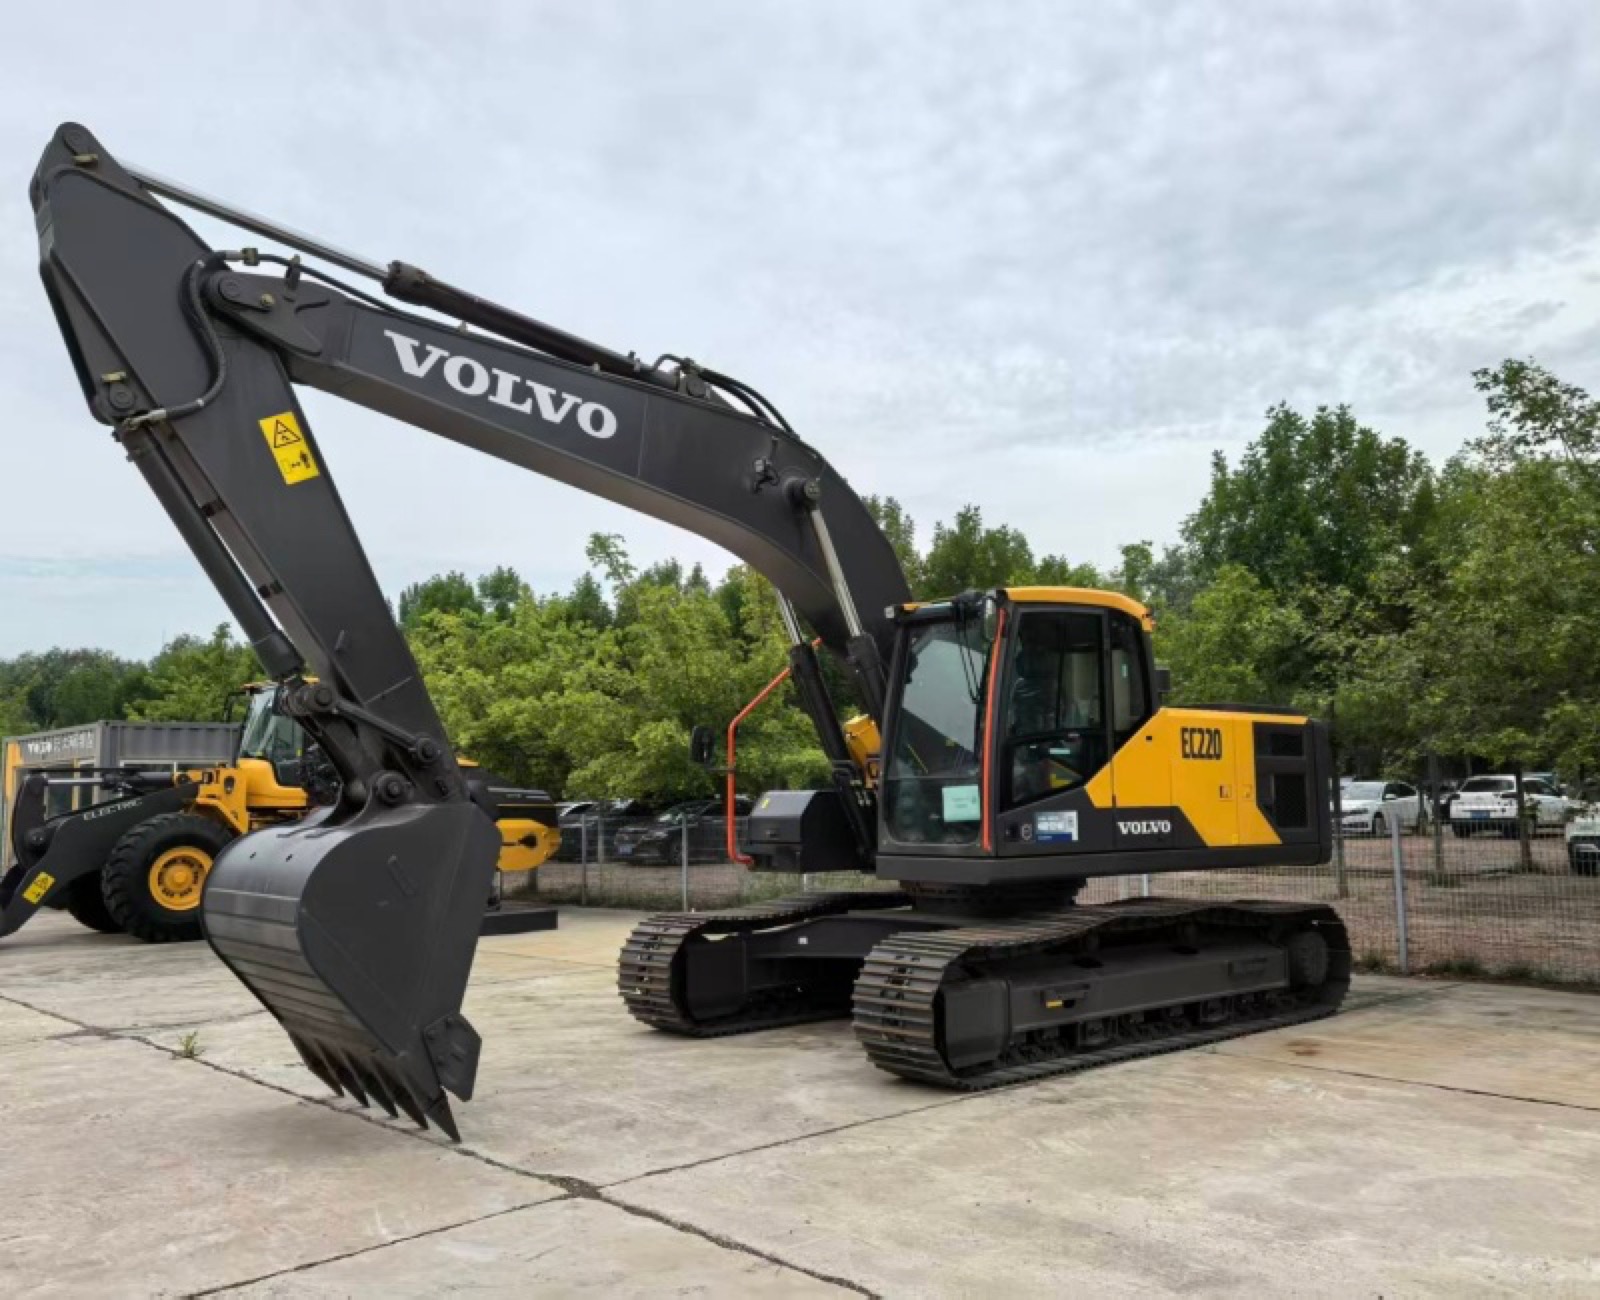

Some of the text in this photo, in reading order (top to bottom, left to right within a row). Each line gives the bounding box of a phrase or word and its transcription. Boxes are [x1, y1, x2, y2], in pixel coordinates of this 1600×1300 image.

[384, 330, 617, 438] VOLVO
[1181, 727, 1222, 760] EC220
[1117, 820, 1171, 835] VOLVO
